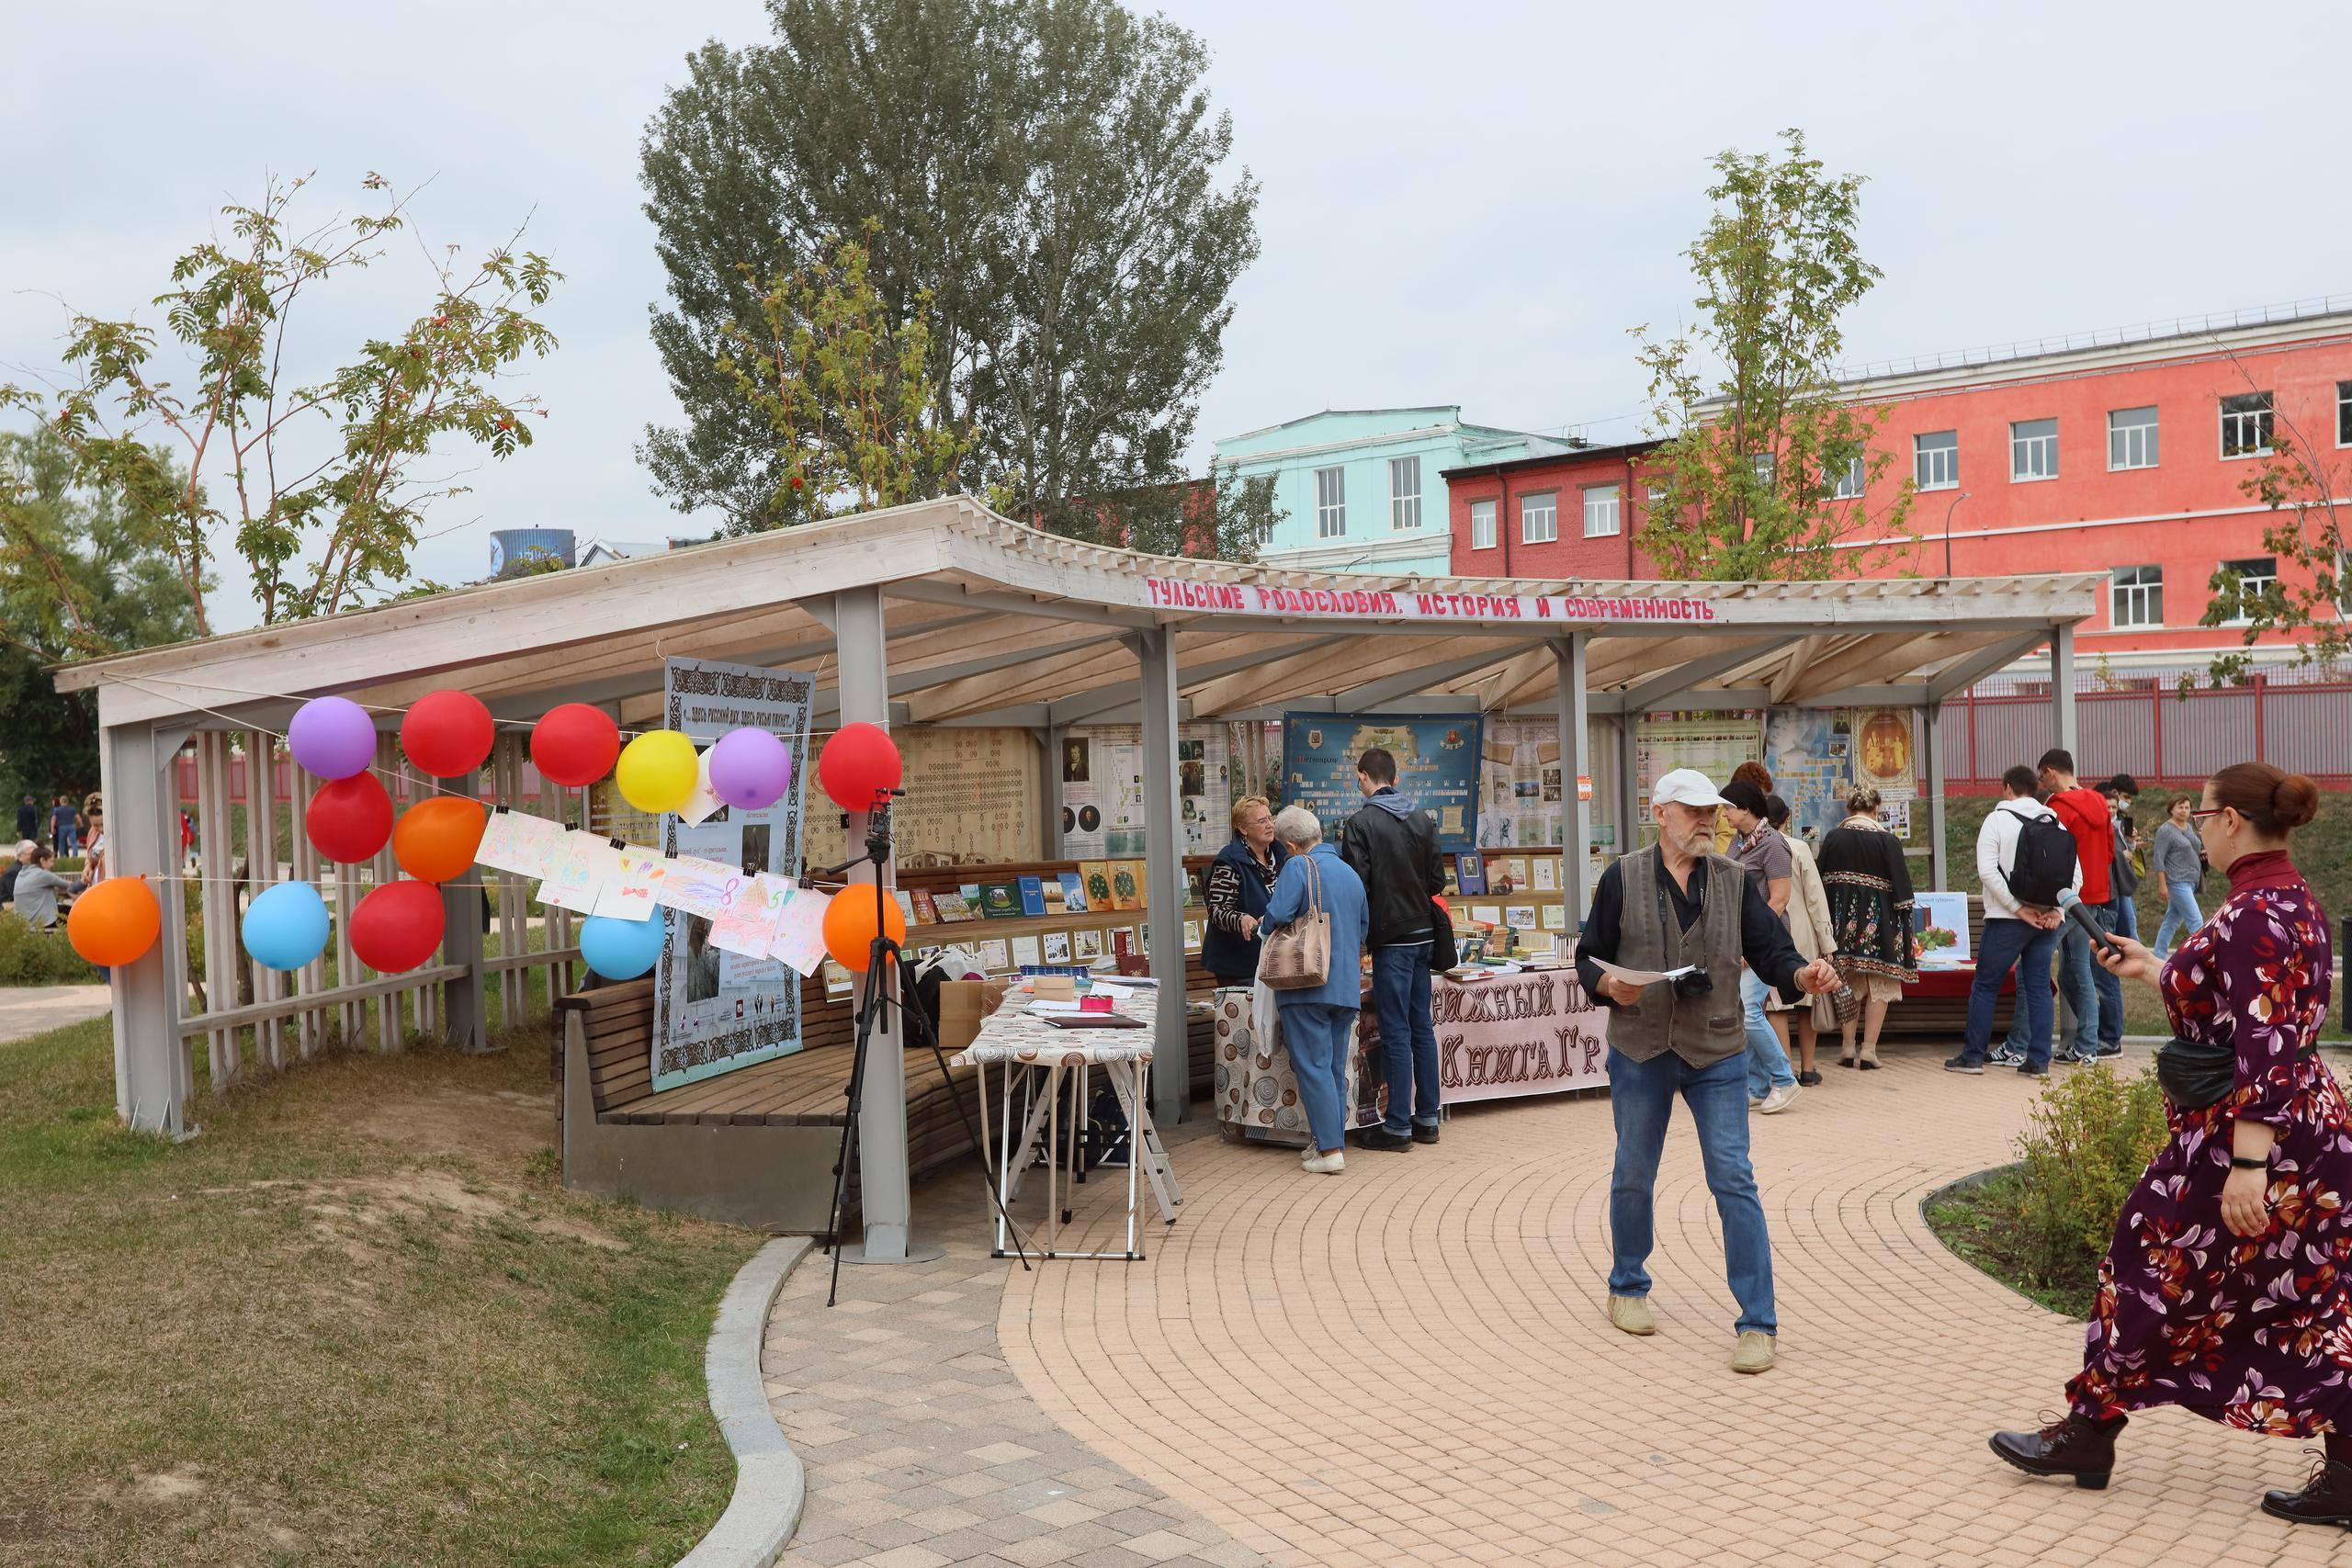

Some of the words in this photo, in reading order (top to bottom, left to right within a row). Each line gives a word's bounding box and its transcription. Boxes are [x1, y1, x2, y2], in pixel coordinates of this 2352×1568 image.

[1148, 579, 1245, 609] ТУЛЬСКИЕ
[1417, 593, 1521, 617] ИСТОРИЯ
[1535, 598, 1551, 617] И
[1565, 598, 1714, 620] СОВРЕМЕННОСТЬ
[1430, 973, 1557, 1026] НИЖНЫЙ
